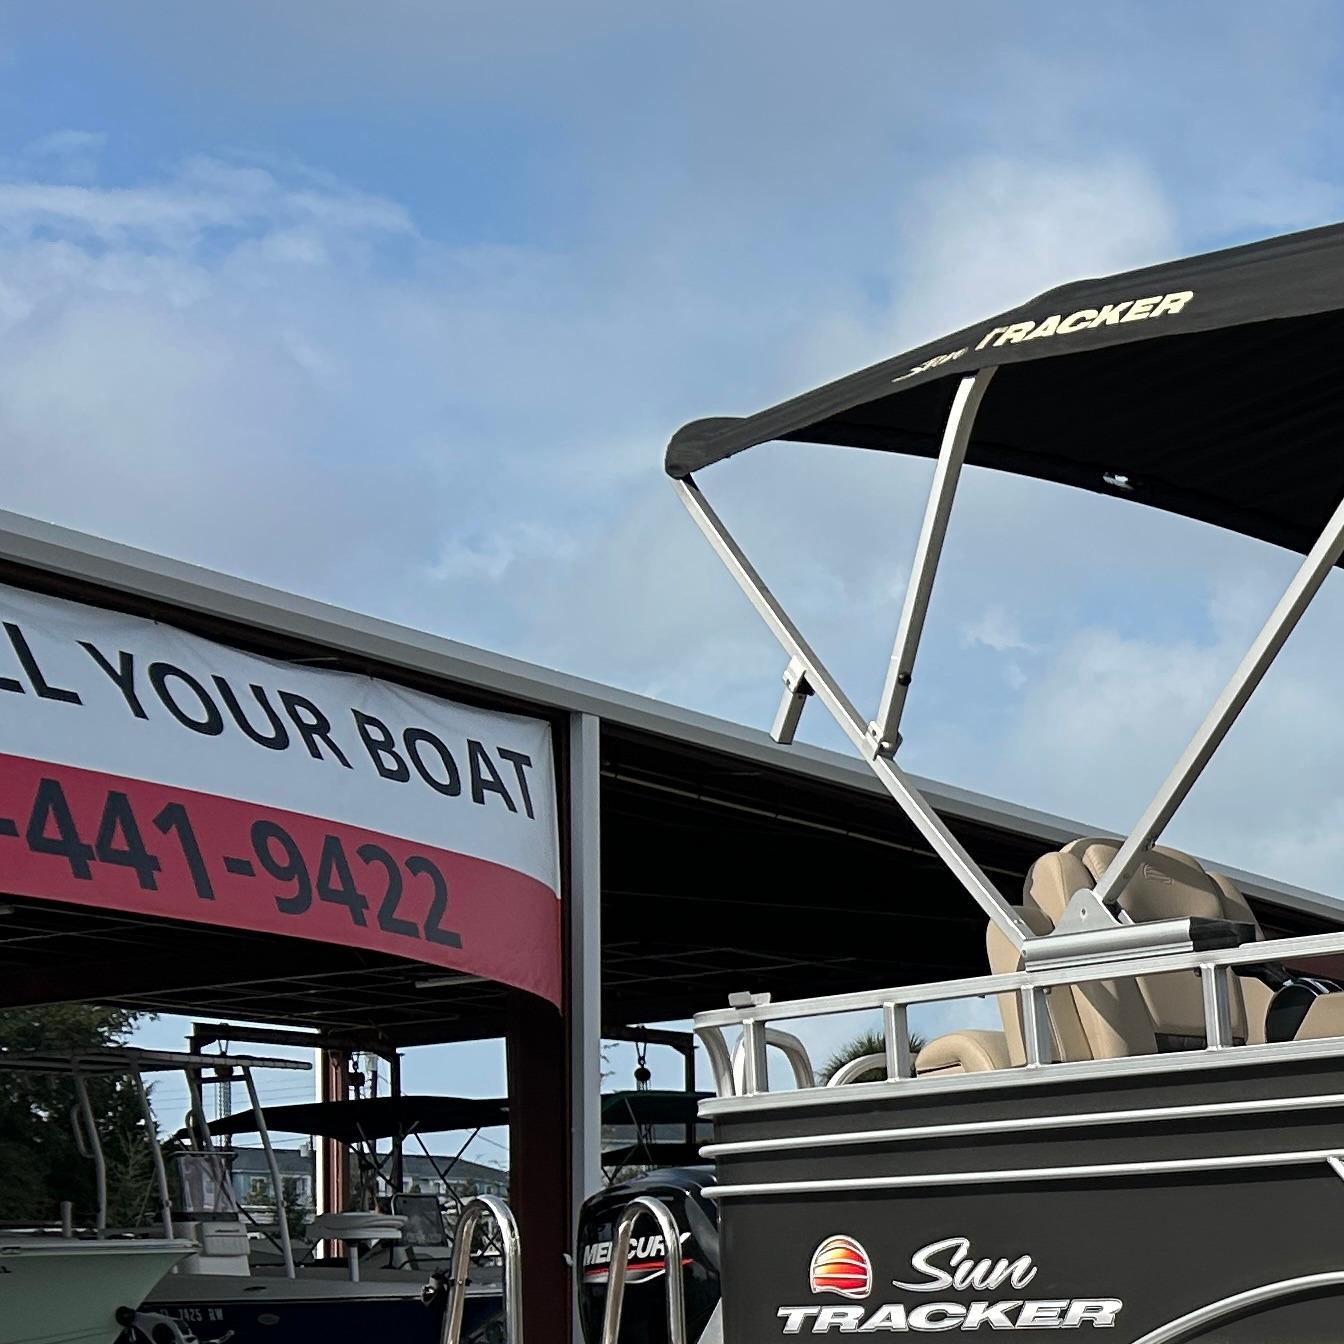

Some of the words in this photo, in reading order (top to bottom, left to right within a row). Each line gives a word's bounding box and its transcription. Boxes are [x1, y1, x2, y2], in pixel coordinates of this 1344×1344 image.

[0, 621, 84, 706] L
[76, 640, 354, 770] YOUR
[351, 708, 535, 820] BOAT
[892, 1237, 1038, 1292] Sun
[777, 1298, 1123, 1334] TRACKER
